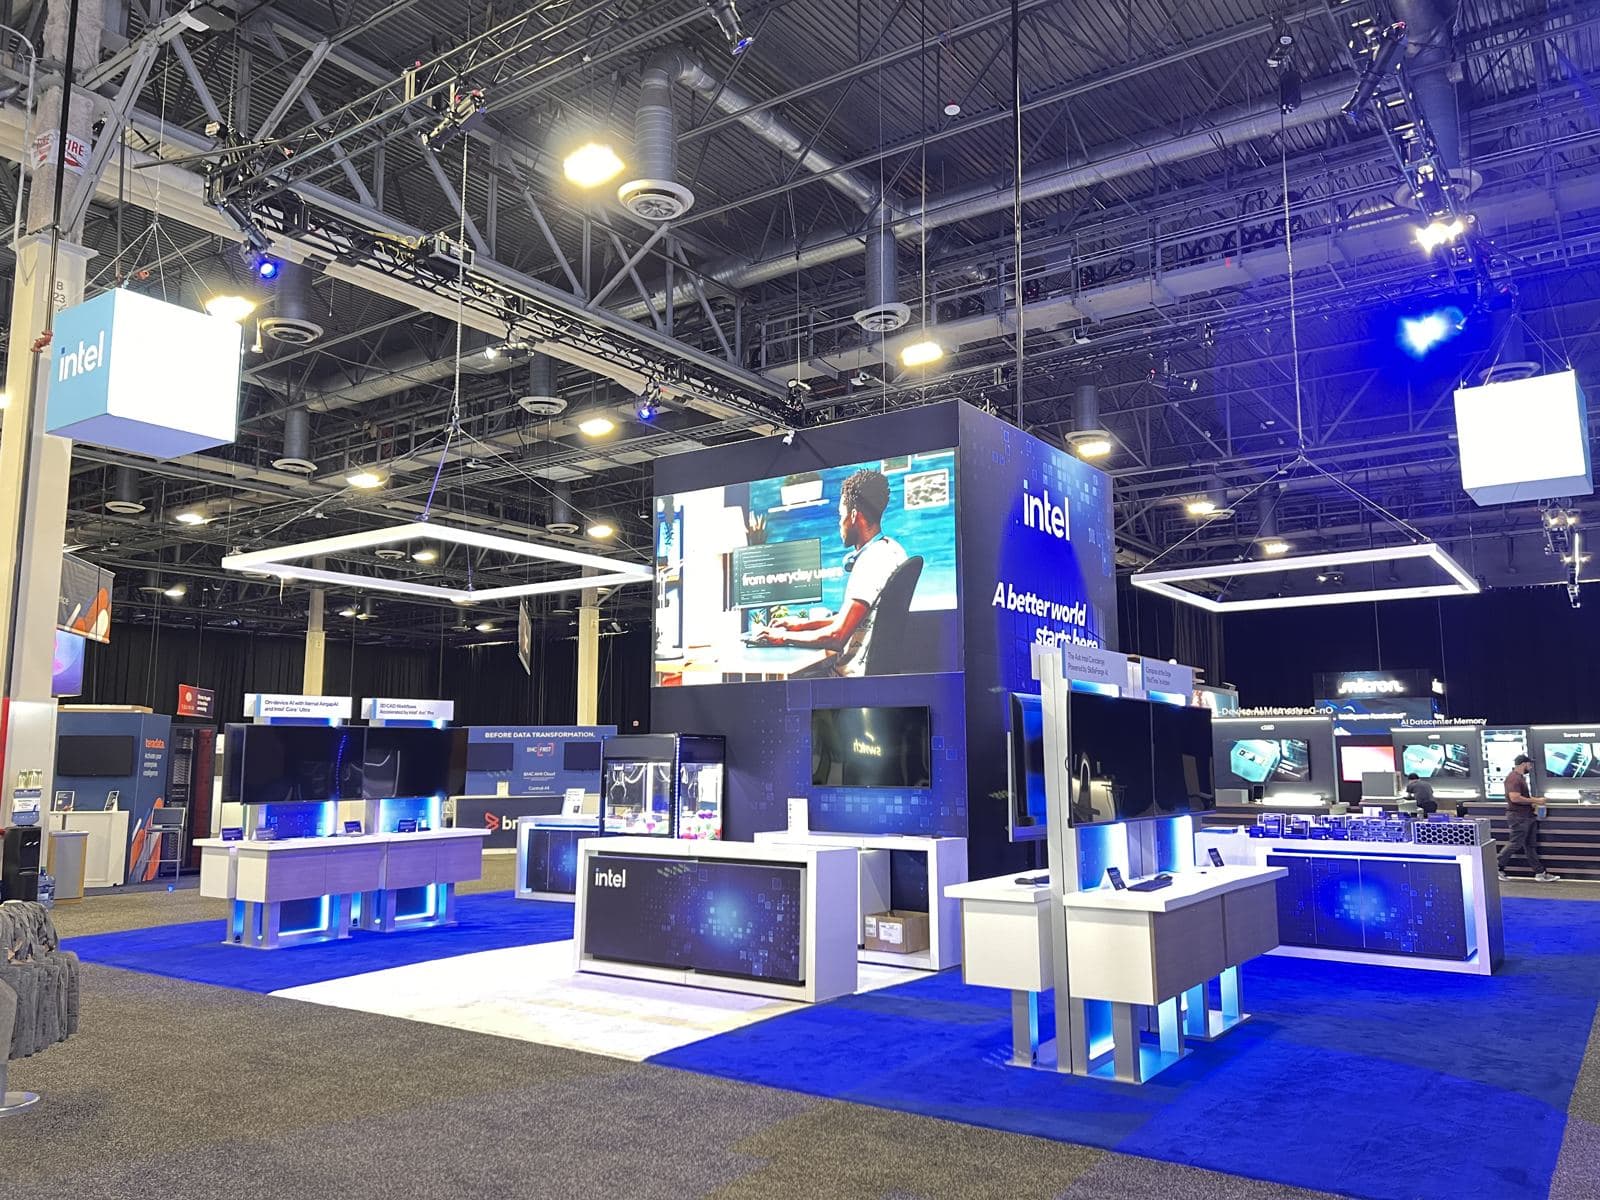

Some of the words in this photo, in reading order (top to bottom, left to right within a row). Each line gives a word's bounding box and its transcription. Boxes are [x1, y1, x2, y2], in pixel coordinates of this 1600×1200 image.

[66, 139, 85, 157] IRE
[58, 330, 105, 383] intel
[1023, 479, 1071, 541] intel
[742, 572, 766, 586] from
[766, 568, 813, 585] everyday
[991, 581, 1006, 608] A
[1006, 583, 1051, 618] better
[1051, 599, 1087, 627] world
[1409, 718, 1453, 726] Datacenter
[1453, 718, 1487, 727] Memory
[594, 867, 627, 888] intel
